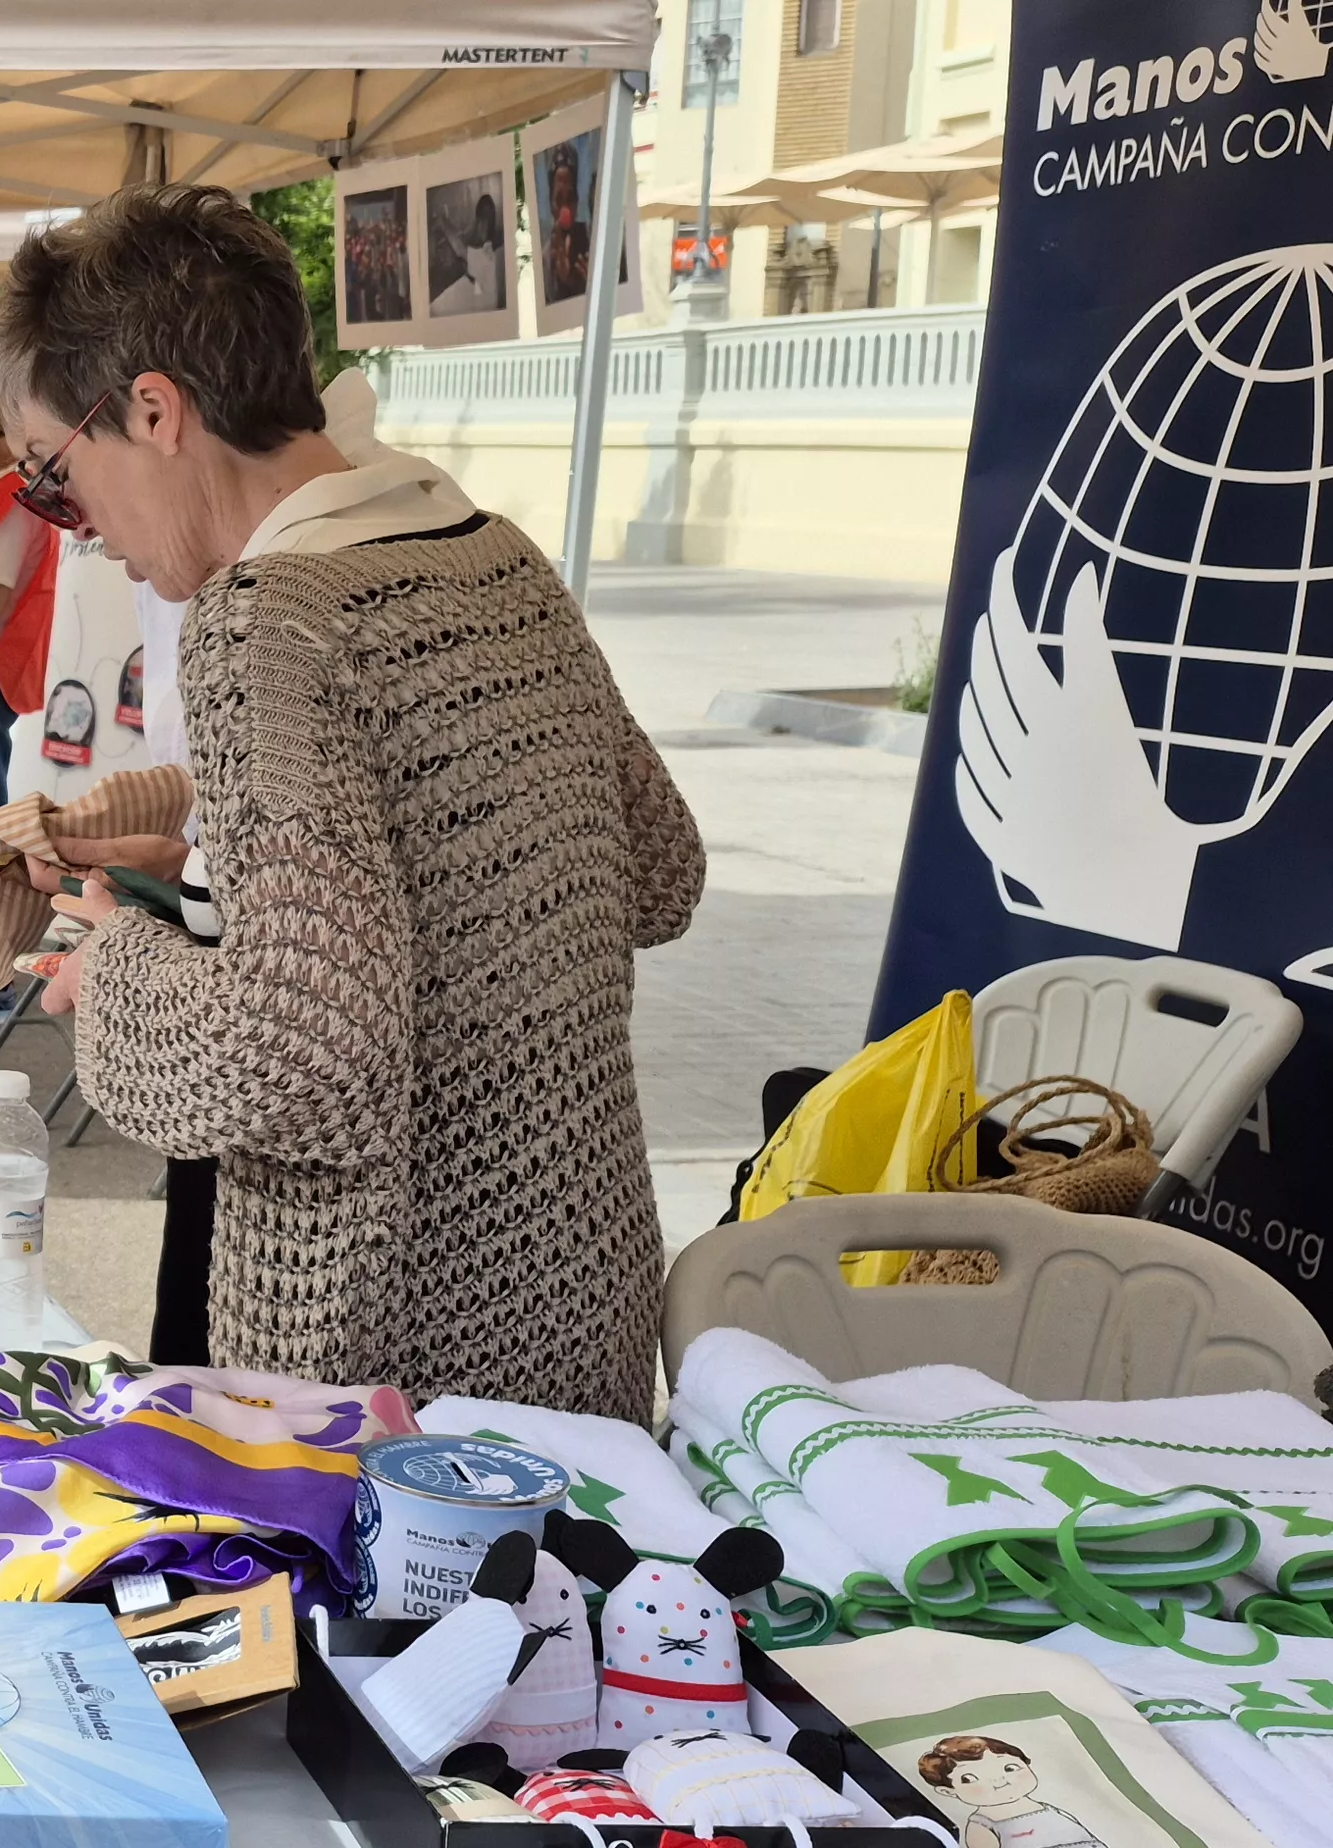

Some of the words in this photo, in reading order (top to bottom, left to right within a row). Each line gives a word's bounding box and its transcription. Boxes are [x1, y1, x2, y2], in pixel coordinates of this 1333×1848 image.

[441, 47, 569, 64] MASTERTENT
[1036, 37, 1248, 132] Manos
[1033, 116, 1208, 197] CAMPAÑA
[1221, 104, 1333, 164] CON
[380, 1440, 432, 1455] HAMBRE
[460, 1443, 557, 1478] Unidas
[406, 1528, 455, 1546] Manos
[406, 1538, 450, 1554] CAMPAÑA
[405, 1559, 472, 1584] NUEST
[403, 1598, 442, 1620] LOS
[41, 1652, 67, 1679] CAMPAÑA
[55, 1682, 76, 1706] CONTRA
[71, 1714, 94, 1740] HAMBRE
[57, 1652, 85, 1684] Manos
[83, 1704, 114, 1742] Unidas
